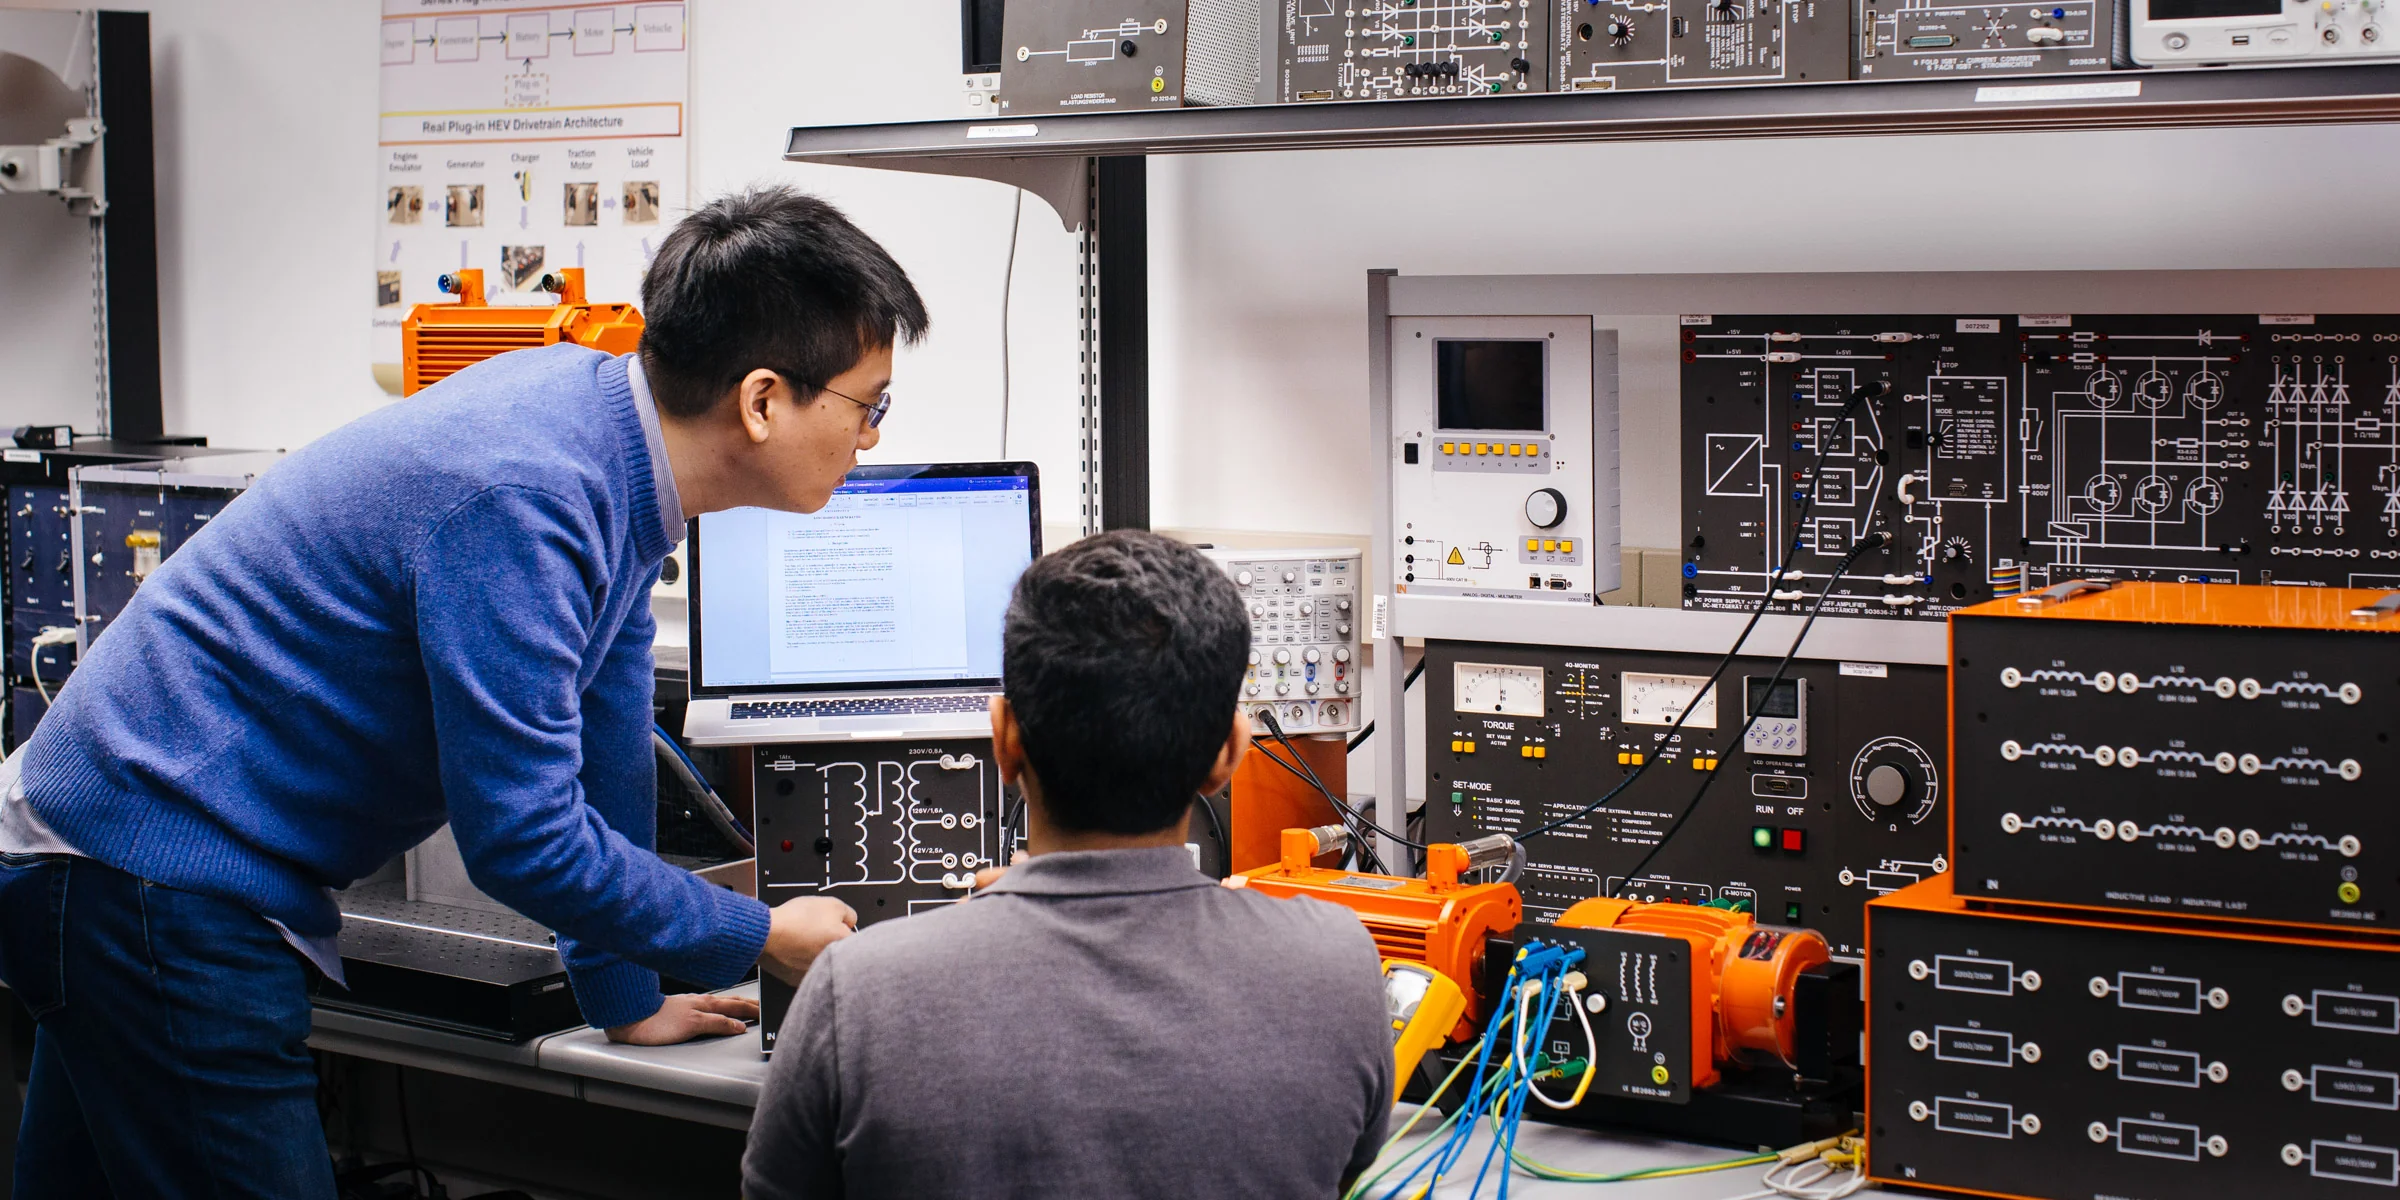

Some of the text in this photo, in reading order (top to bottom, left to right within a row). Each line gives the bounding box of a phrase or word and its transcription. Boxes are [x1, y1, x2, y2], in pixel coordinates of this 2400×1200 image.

[1807, 2, 1815, 19] RUN
[421, 115, 623, 134] Real Plug-in HEV Drivetrain Architecture
[567, 148, 596, 158] Traction
[626, 146, 654, 157] Vehicle
[393, 152, 418, 163] Engine
[511, 152, 540, 165] Charger
[631, 158, 650, 168] Load
[389, 162, 422, 173] Emulator
[446, 158, 485, 169] Generator
[569, 160, 593, 170] Motor
[1482, 720, 1516, 731] TORQUE
[1653, 732, 1682, 743] SPED
[1765, 760, 1793, 768] OPERATING
[1452, 780, 1492, 792] SET-MODE
[1505, 798, 1521, 806] MODE
[1504, 807, 1526, 815] CONTROL
[1755, 804, 1774, 815] RUN
[1786, 806, 1805, 816] OFF
[1889, 823, 1898, 832] Ω
[2105, 890, 2147, 902] INDUCTIVE
[2148, 893, 2171, 904] LOAD
[2225, 901, 2248, 911] LAST
